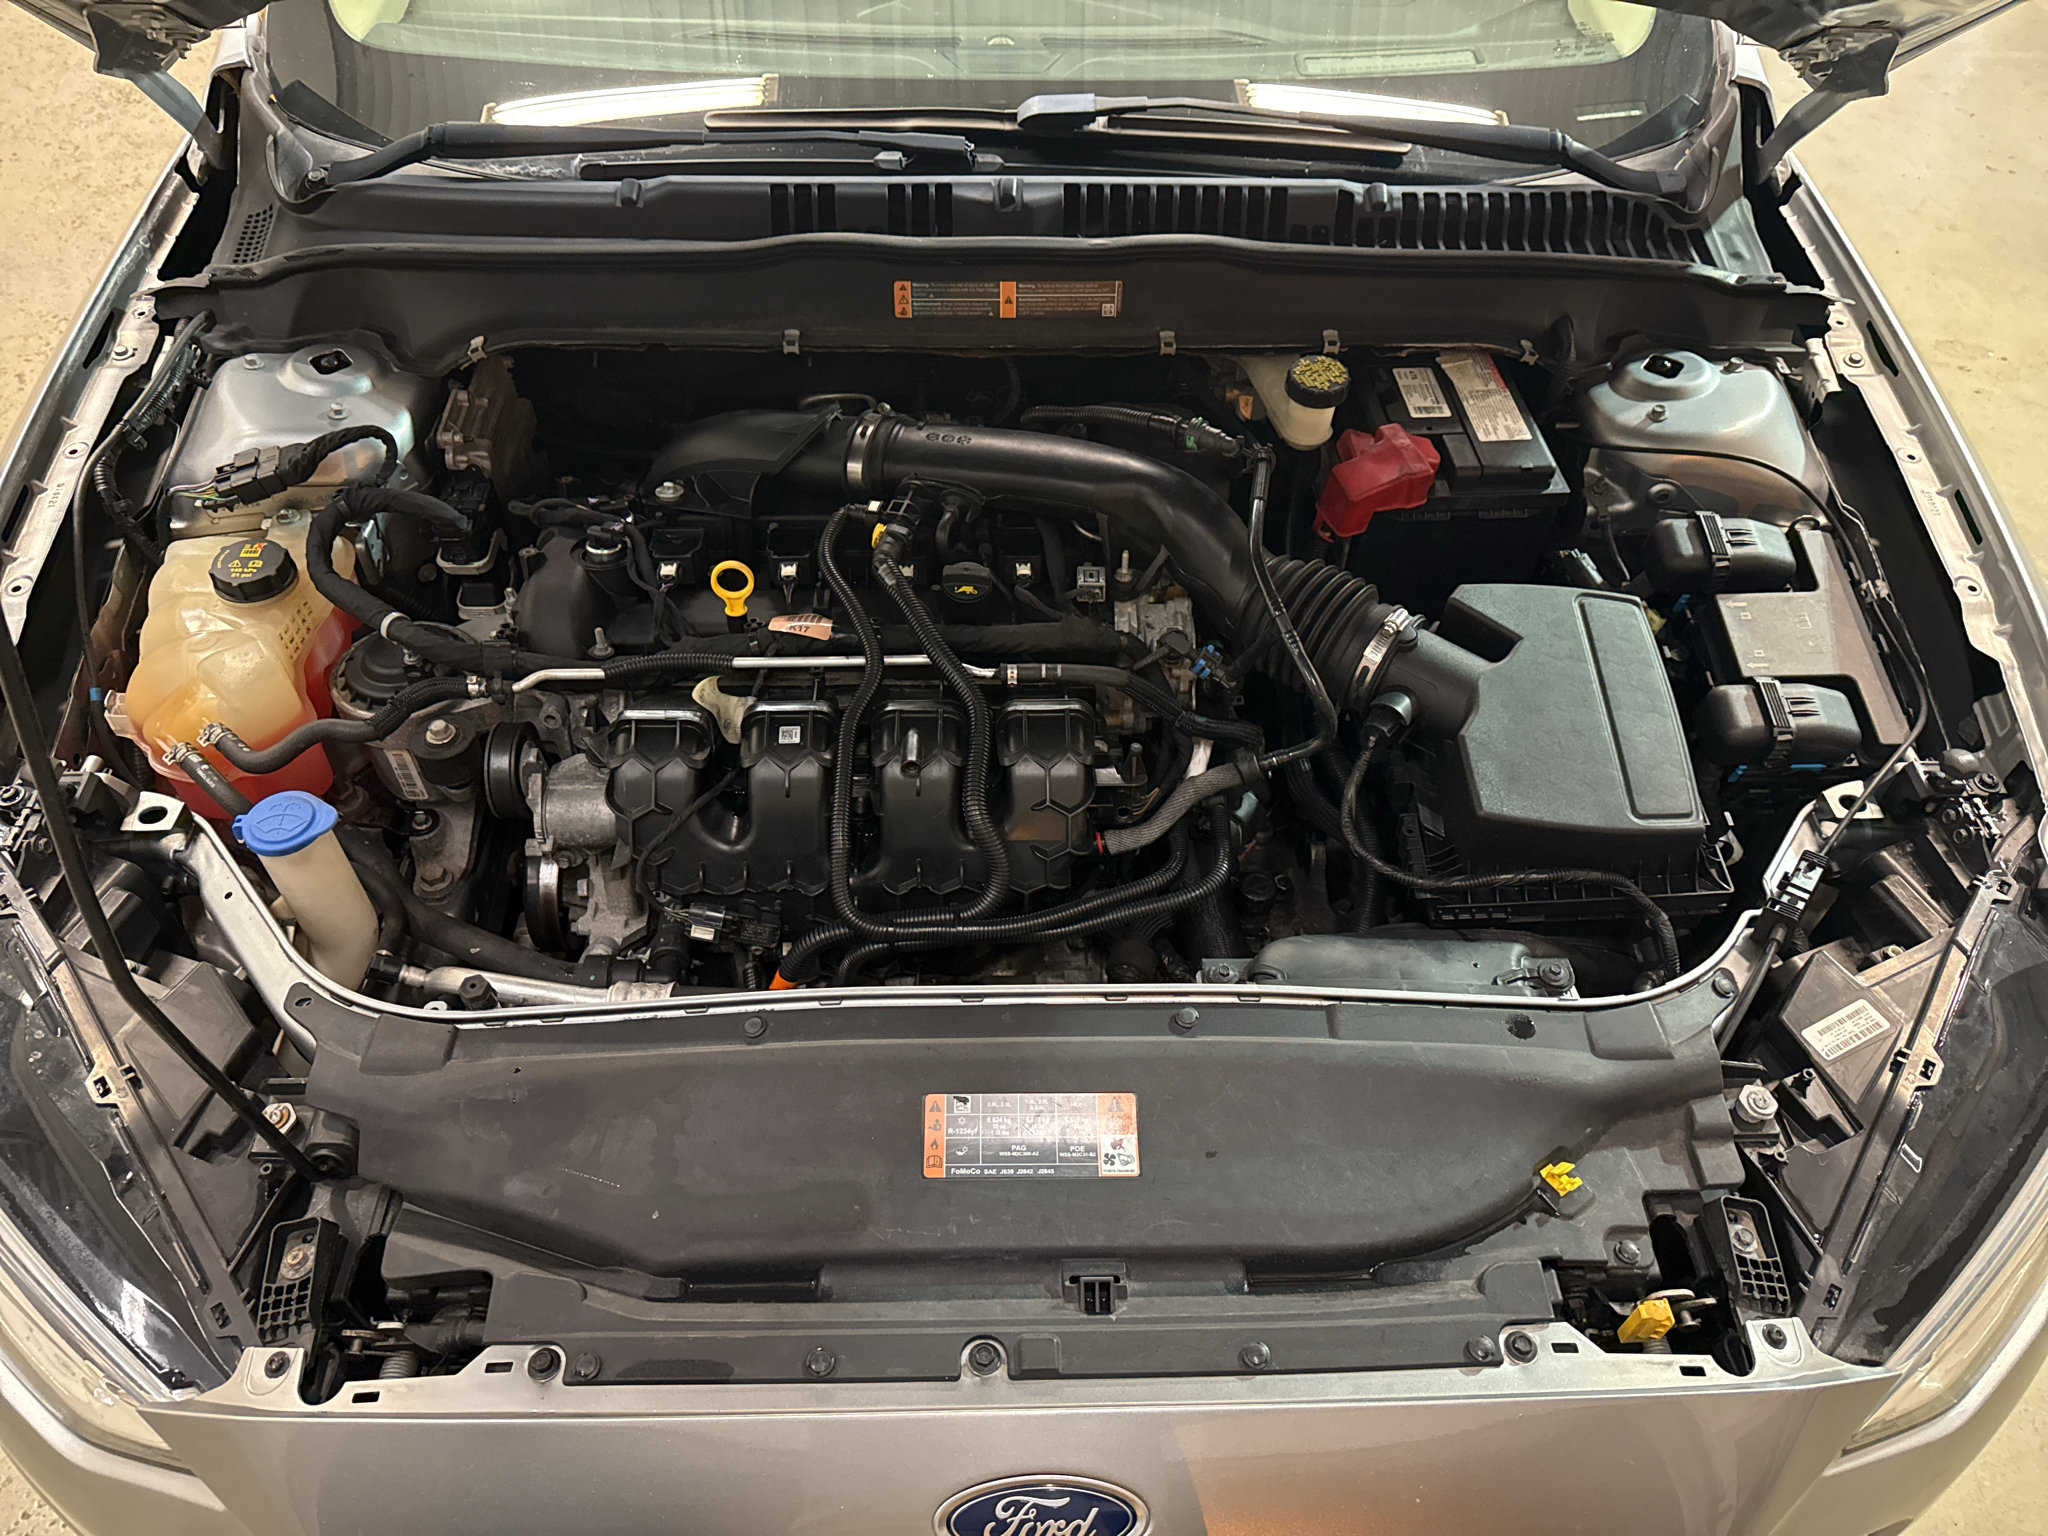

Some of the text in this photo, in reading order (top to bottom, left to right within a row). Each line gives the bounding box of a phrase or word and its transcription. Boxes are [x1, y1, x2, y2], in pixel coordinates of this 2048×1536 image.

[947, 1122, 979, 1136] R-1234yf
[950, 1167, 981, 1175] FoMoCo
[983, 1496, 1099, 1536] Ford
